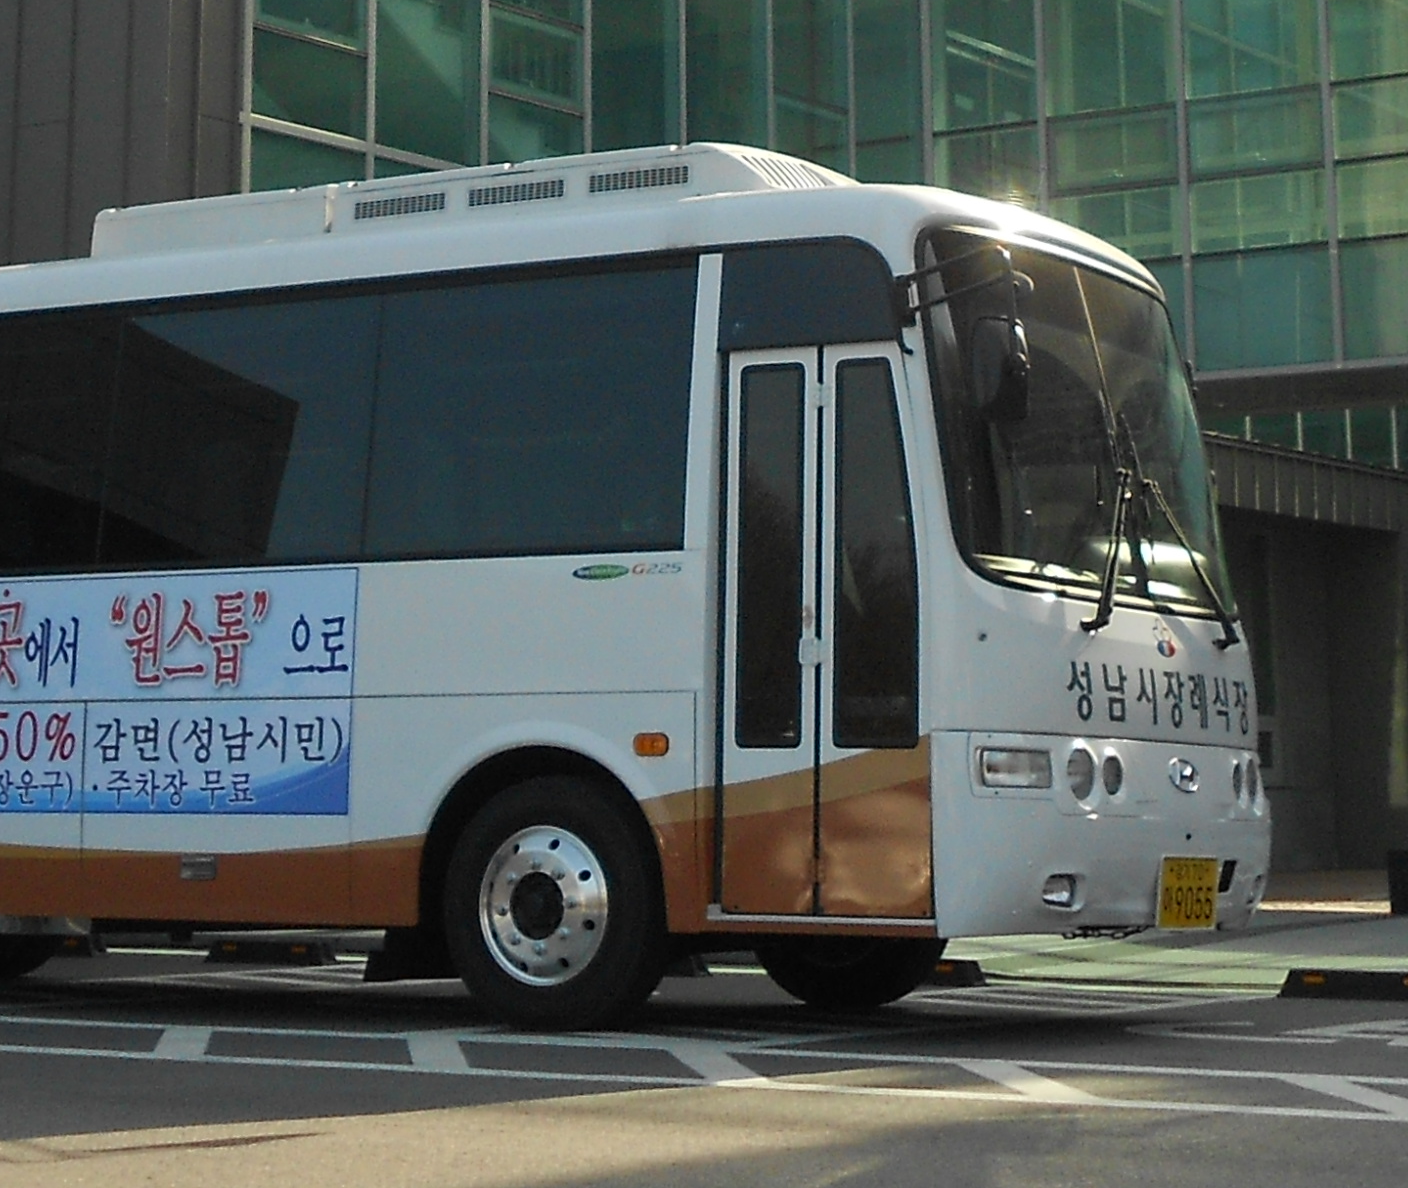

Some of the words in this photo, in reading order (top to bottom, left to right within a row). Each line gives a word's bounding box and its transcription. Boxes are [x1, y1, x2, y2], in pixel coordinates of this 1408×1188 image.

[282, 613, 349, 675] 으로
[1066, 660, 1250, 736] 성남시장례식장
[93, 716, 346, 764] 감면(성남시민)
[199, 770, 254, 805] 무료
